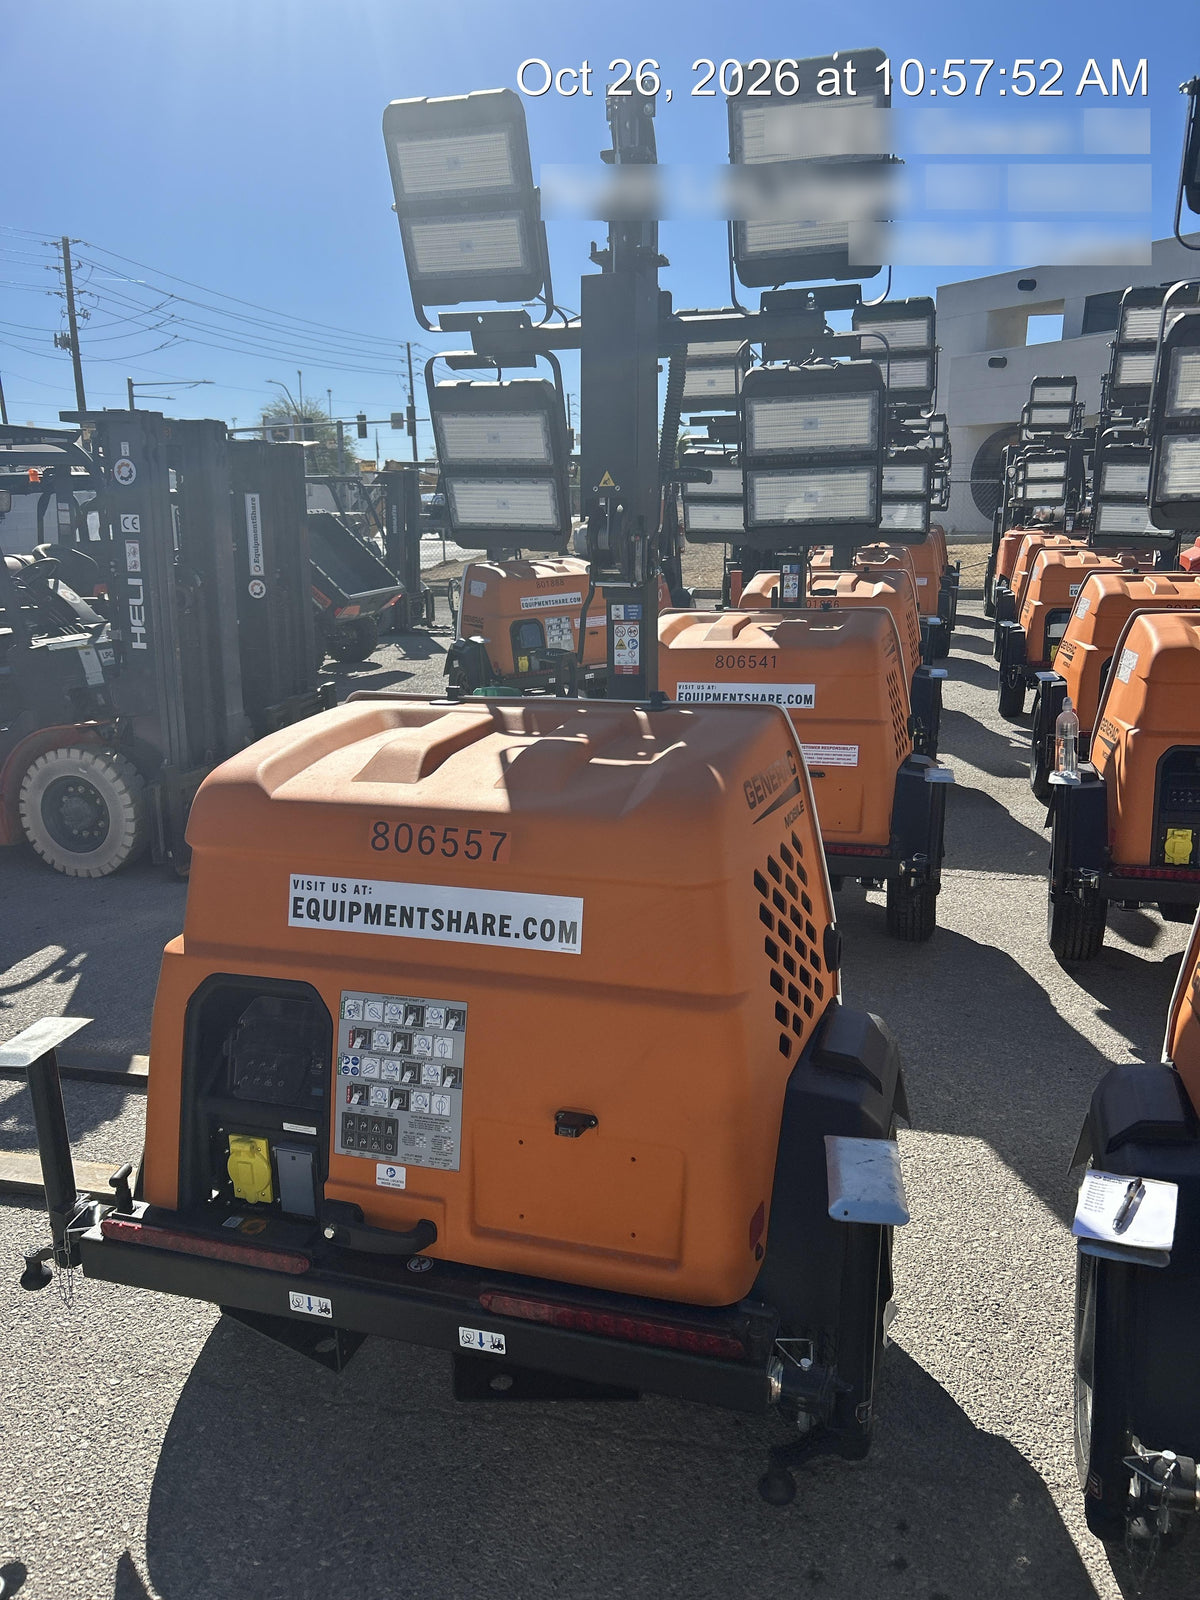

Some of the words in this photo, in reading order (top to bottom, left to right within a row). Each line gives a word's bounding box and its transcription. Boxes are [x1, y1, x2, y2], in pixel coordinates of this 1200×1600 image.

[250, 497, 261, 564] EquipmentShare
[127, 578, 148, 650] HELI
[521, 597, 582, 609] EQUIPMENTSHARE.COM
[714, 655, 777, 669] 806541
[678, 692, 813, 705] EQUIPMENTSHARE.COM
[370, 821, 508, 862] 806557
[293, 879, 325, 892] VISIT
[332, 882, 347, 894] US
[353, 884, 372, 896] AT:
[292, 896, 578, 945] EQUIPMENTSHARE.COM
